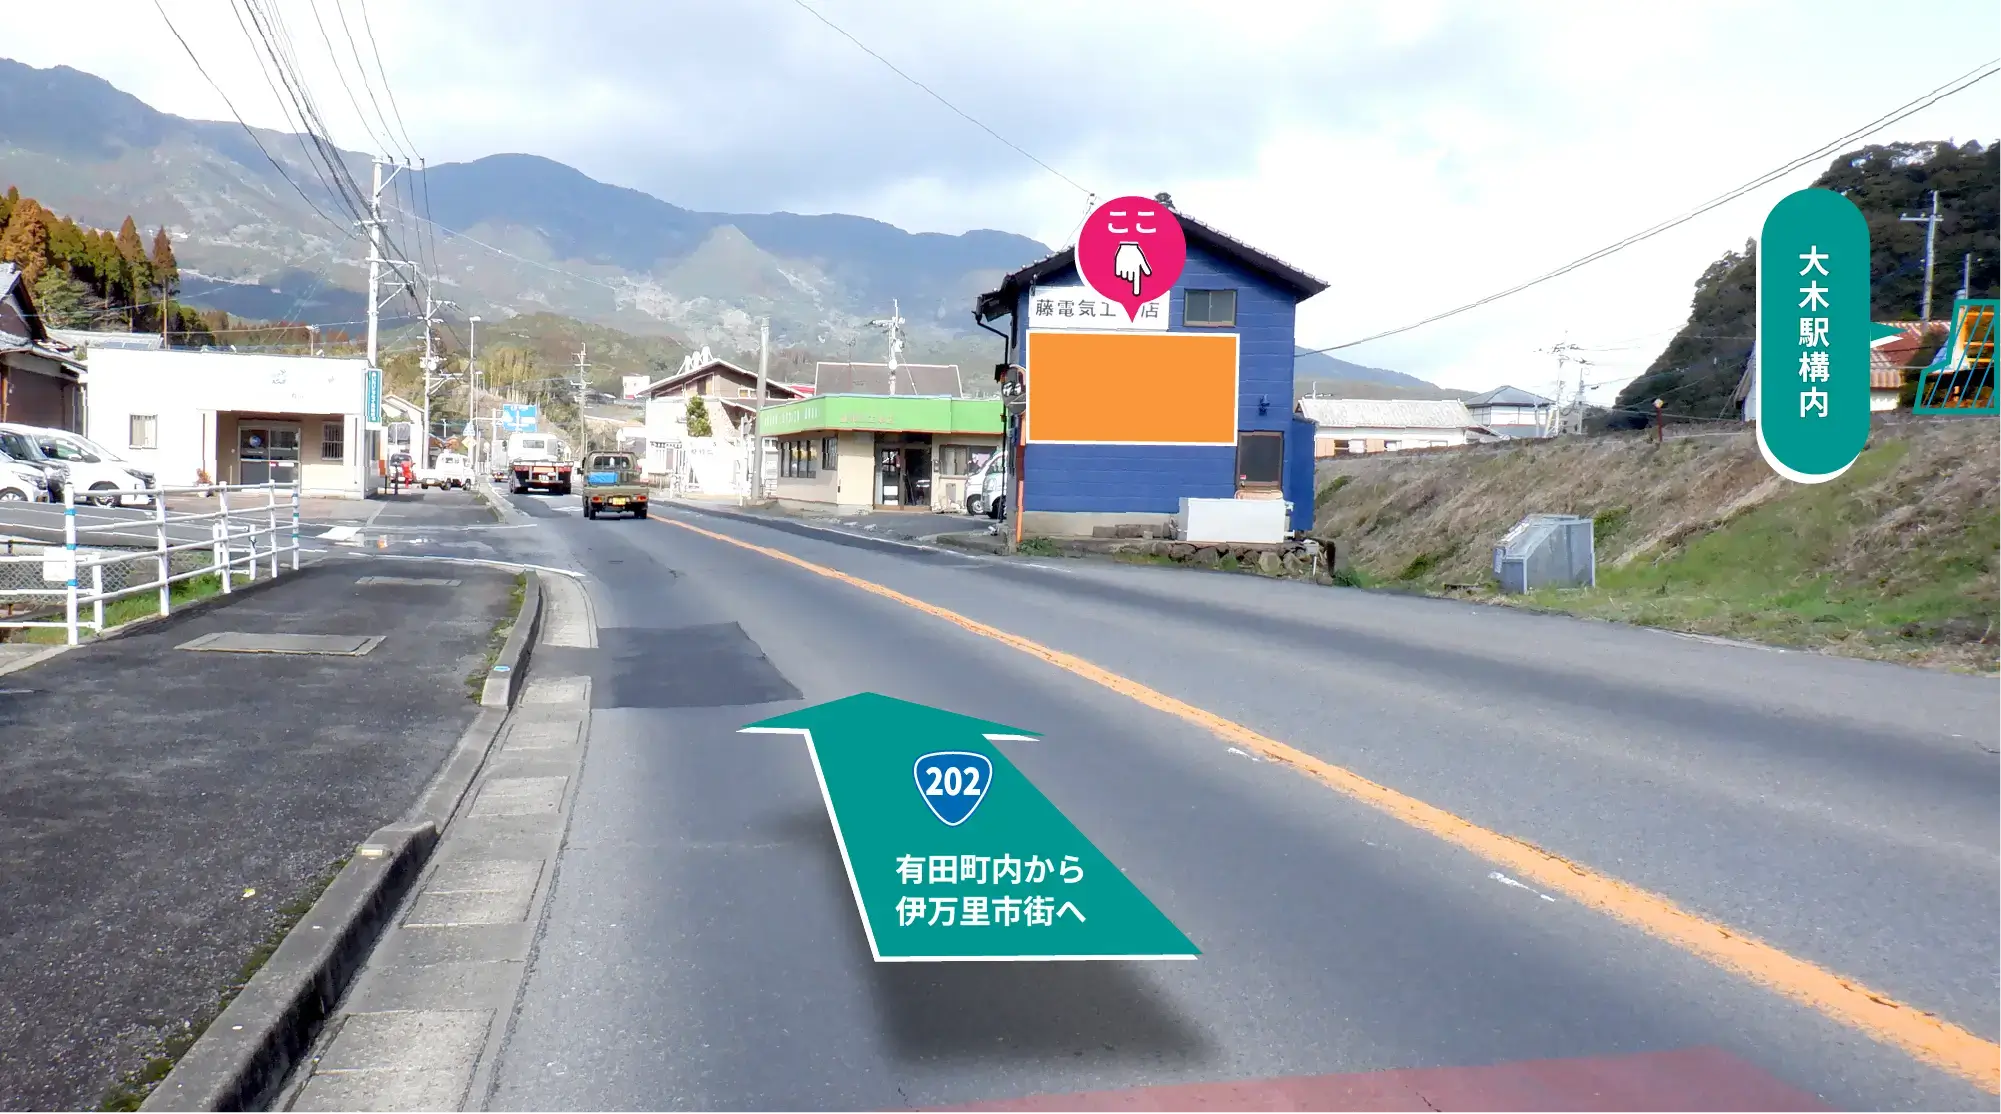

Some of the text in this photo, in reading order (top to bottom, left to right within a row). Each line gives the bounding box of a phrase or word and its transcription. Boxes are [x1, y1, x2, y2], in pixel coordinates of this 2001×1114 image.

[1036, 299, 1160, 318] 藤電気工店
